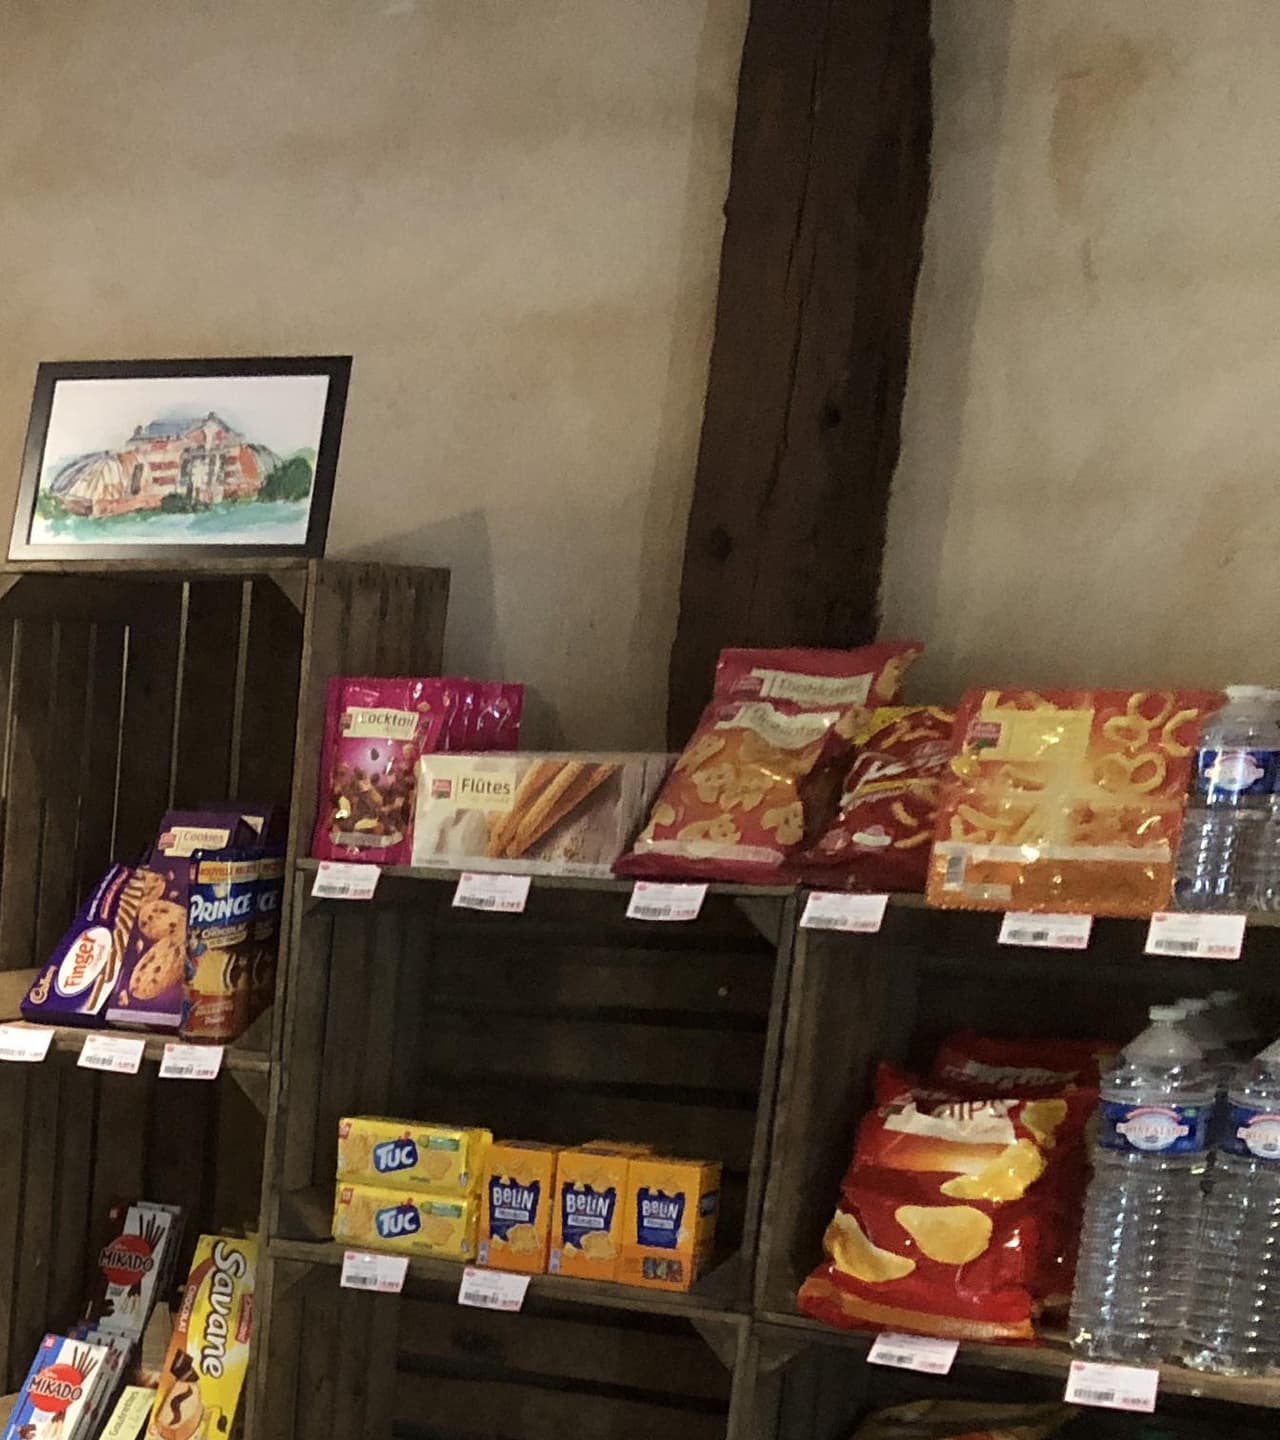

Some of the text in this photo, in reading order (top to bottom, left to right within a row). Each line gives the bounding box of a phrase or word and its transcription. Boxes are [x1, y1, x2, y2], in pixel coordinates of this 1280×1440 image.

[360, 711, 416, 728] Cocktail
[460, 776, 511, 795] Flûtes
[182, 831, 226, 844] Cookies
[190, 892, 253, 926] PRINCE
[64, 930, 97, 989] Finger
[375, 1143, 414, 1170] TUC
[378, 1209, 417, 1236] TUC
[98, 1247, 155, 1273] MIKADO
[202, 1239, 248, 1379] Savane
[27, 1376, 83, 1402] MIKADO
